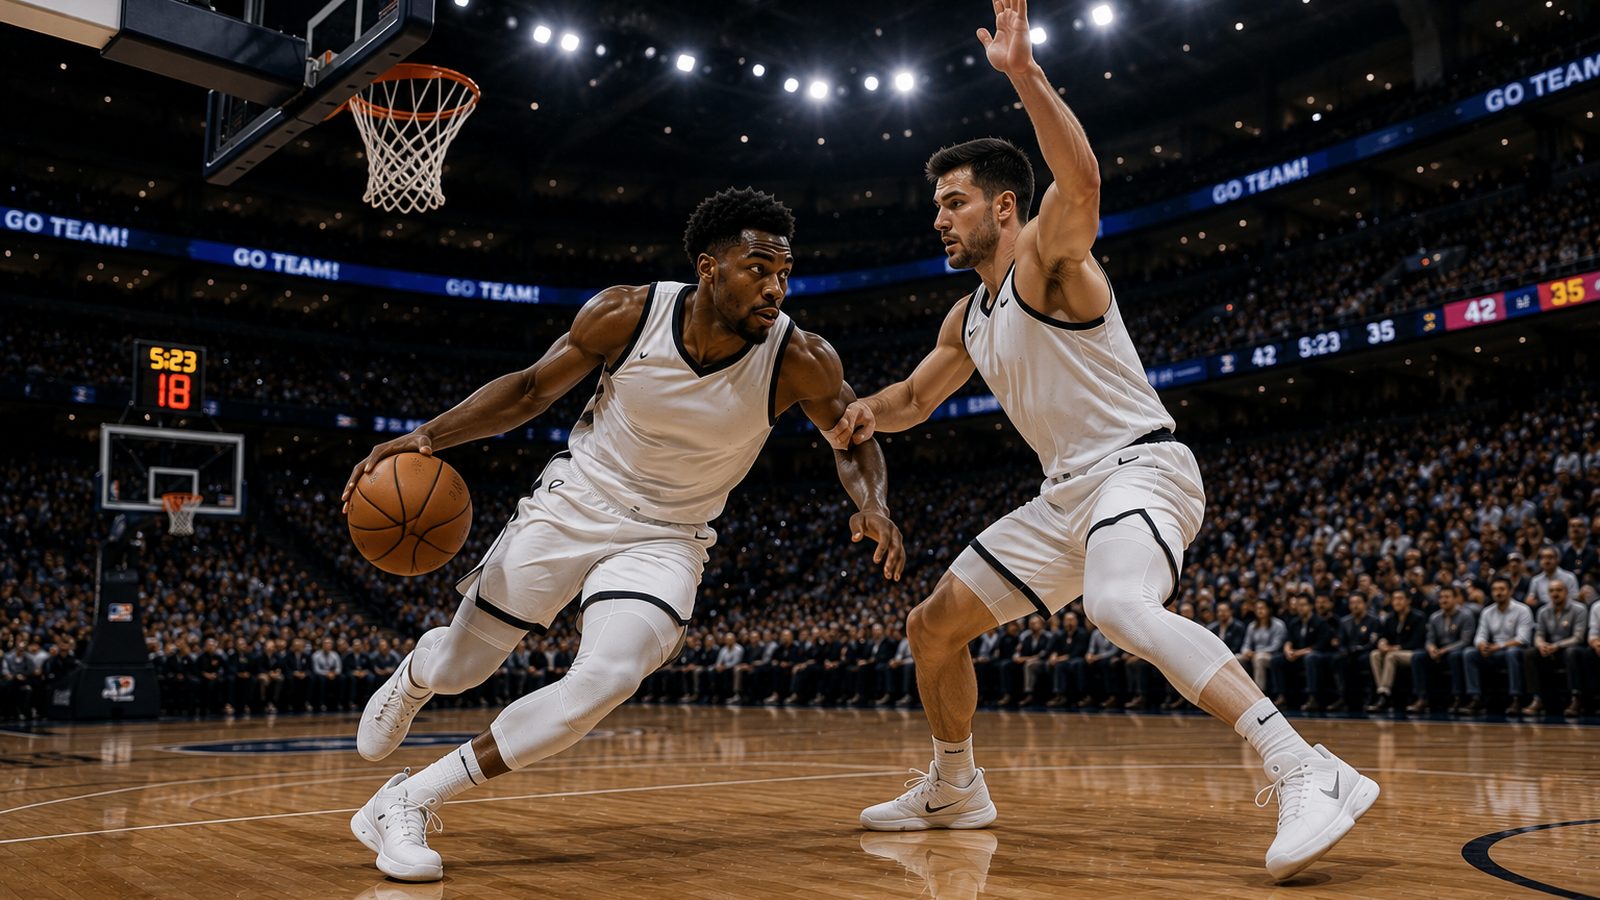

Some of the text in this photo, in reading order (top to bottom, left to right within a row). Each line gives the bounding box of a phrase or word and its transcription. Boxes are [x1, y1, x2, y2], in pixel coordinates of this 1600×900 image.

[1485, 53, 1600, 112] GO TEAM
[1212, 157, 1309, 204] GO TEAM!
[4, 209, 129, 247] GO TEAM!
[233, 247, 340, 279] GO TEAM!
[445, 278, 540, 303] GO TEAM!
[1464, 297, 1497, 323] 42
[1550, 278, 1586, 306] 35
[149, 346, 197, 373] 5:23
[1251, 344, 1277, 367] 42
[1298, 331, 1341, 358] 5:23
[1367, 319, 1396, 344] 35
[158, 373, 191, 410] 18
